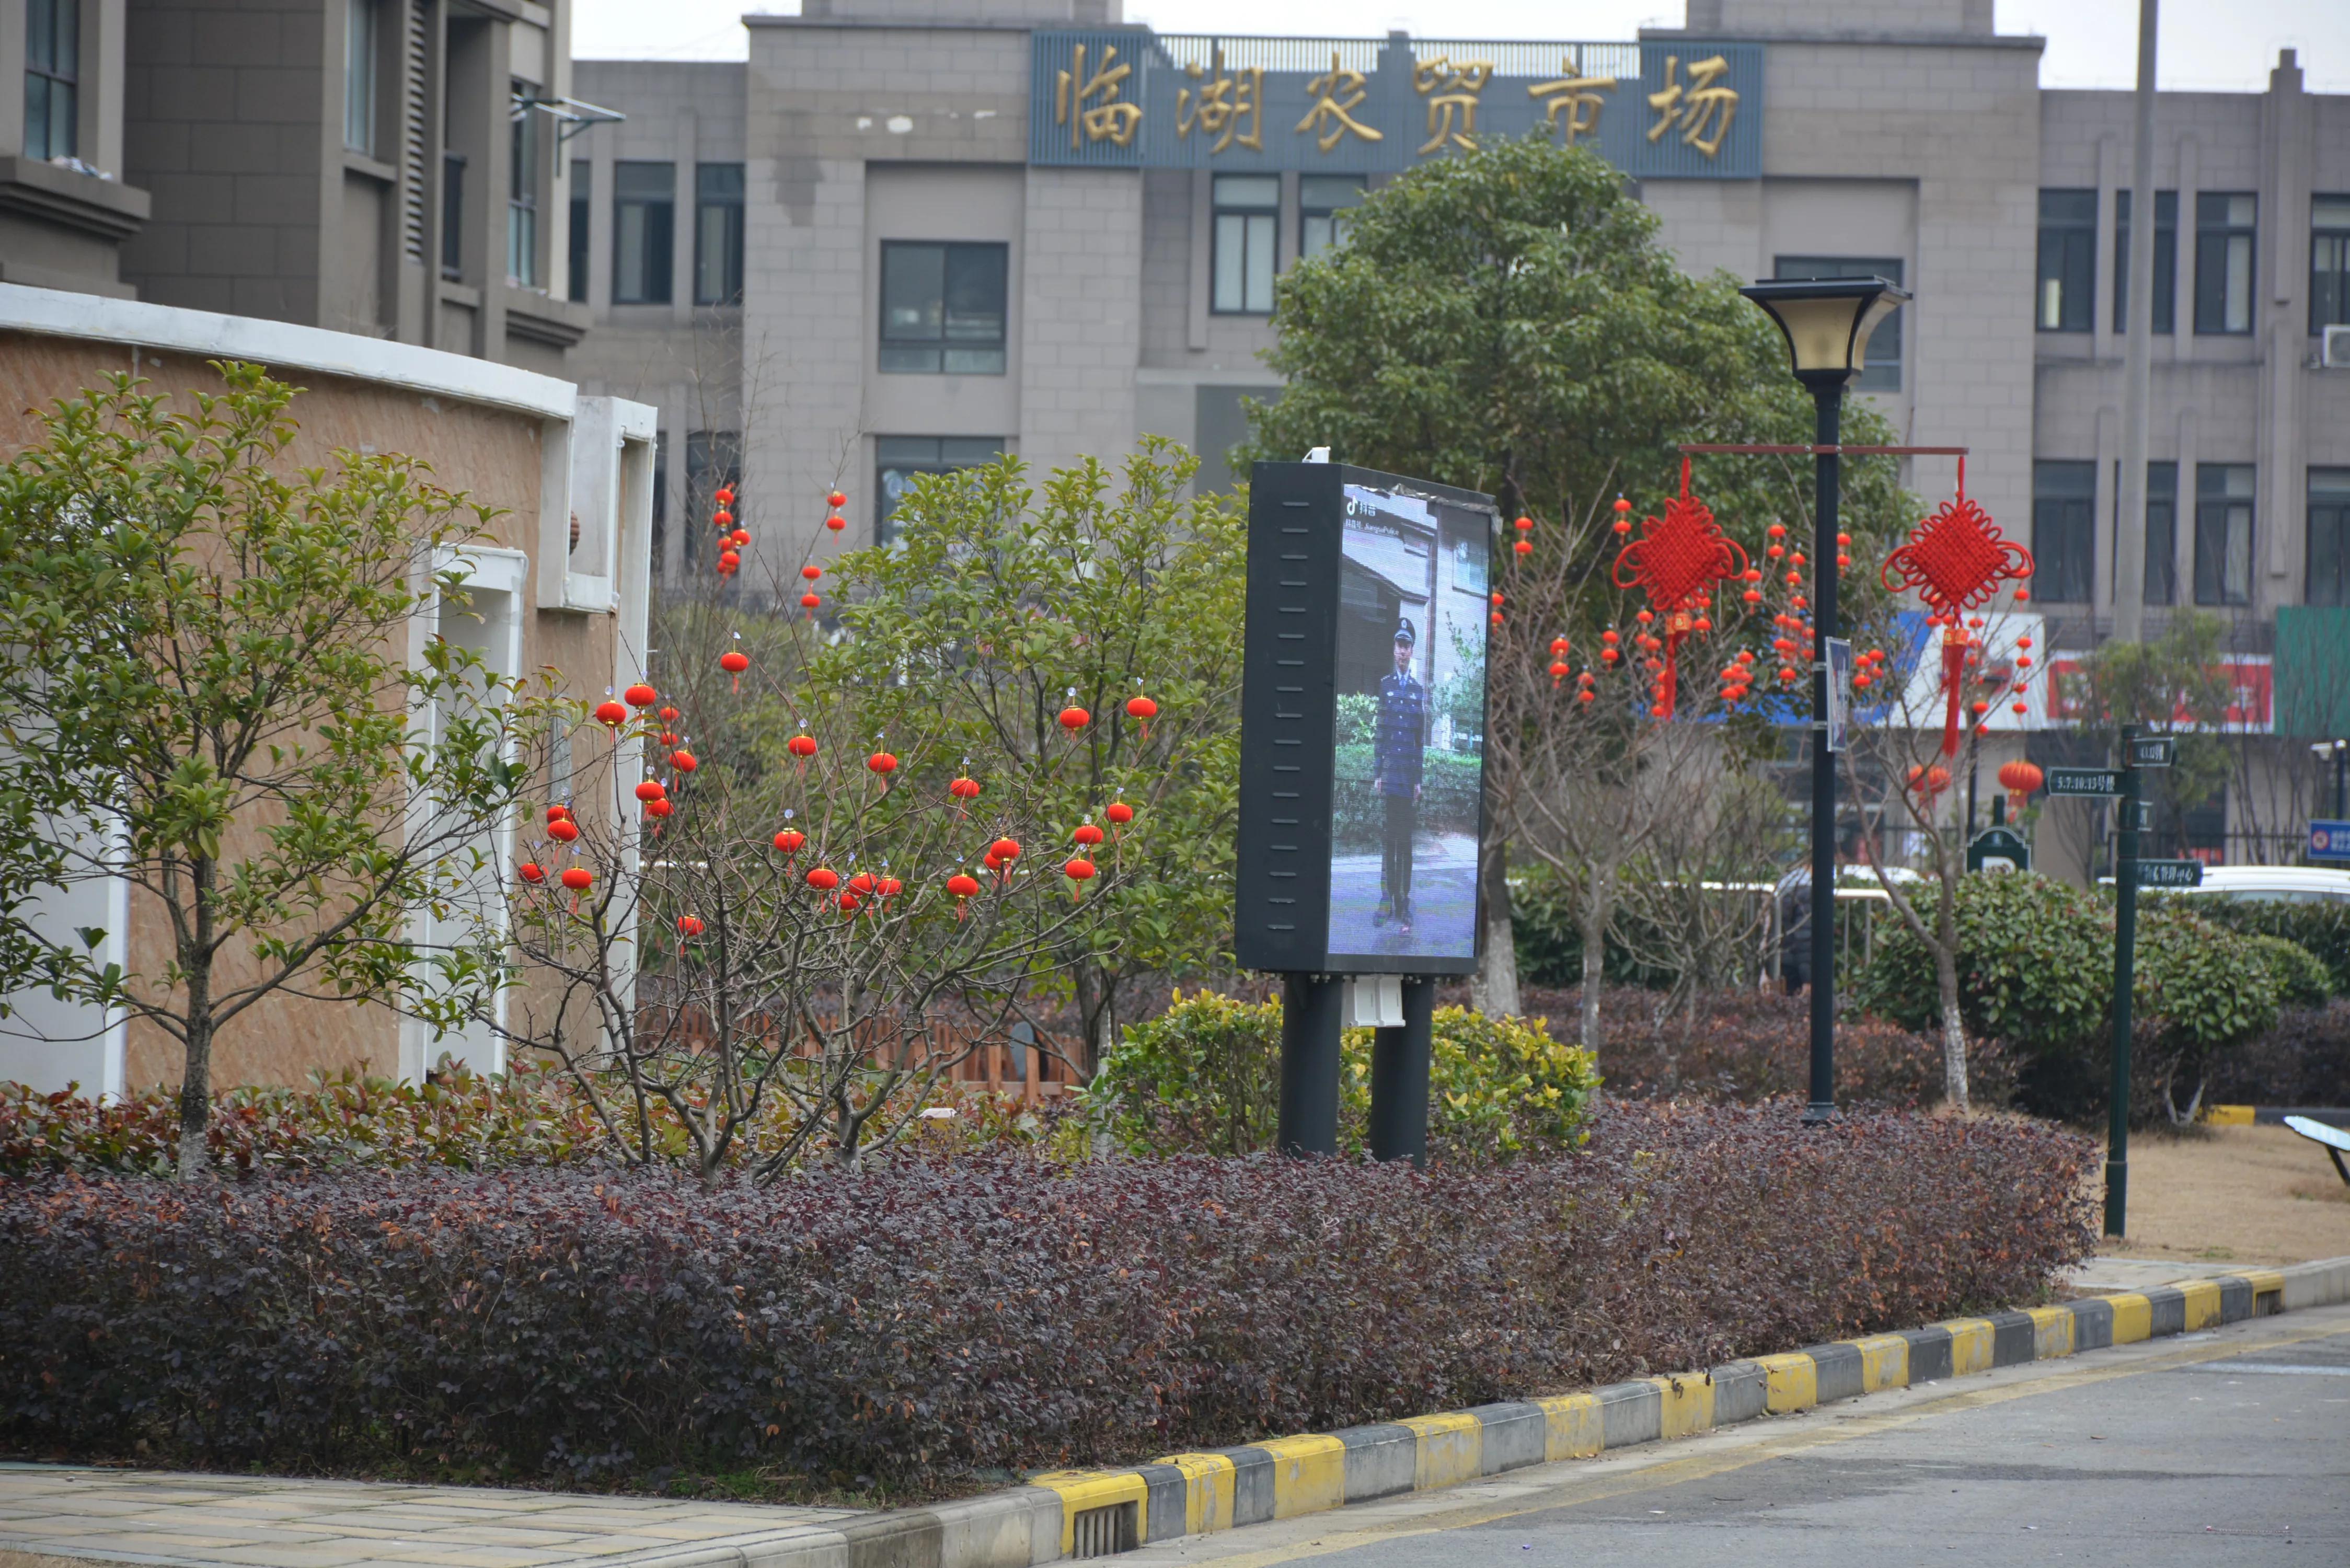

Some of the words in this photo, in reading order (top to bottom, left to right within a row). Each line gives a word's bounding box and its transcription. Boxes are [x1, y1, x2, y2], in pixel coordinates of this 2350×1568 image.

[1057, 42, 1740, 156] 临湖农贸市场
[1360, 502, 1376, 516] 抖音
[2057, 775, 2115, 792] 5.7.10.13号楼
